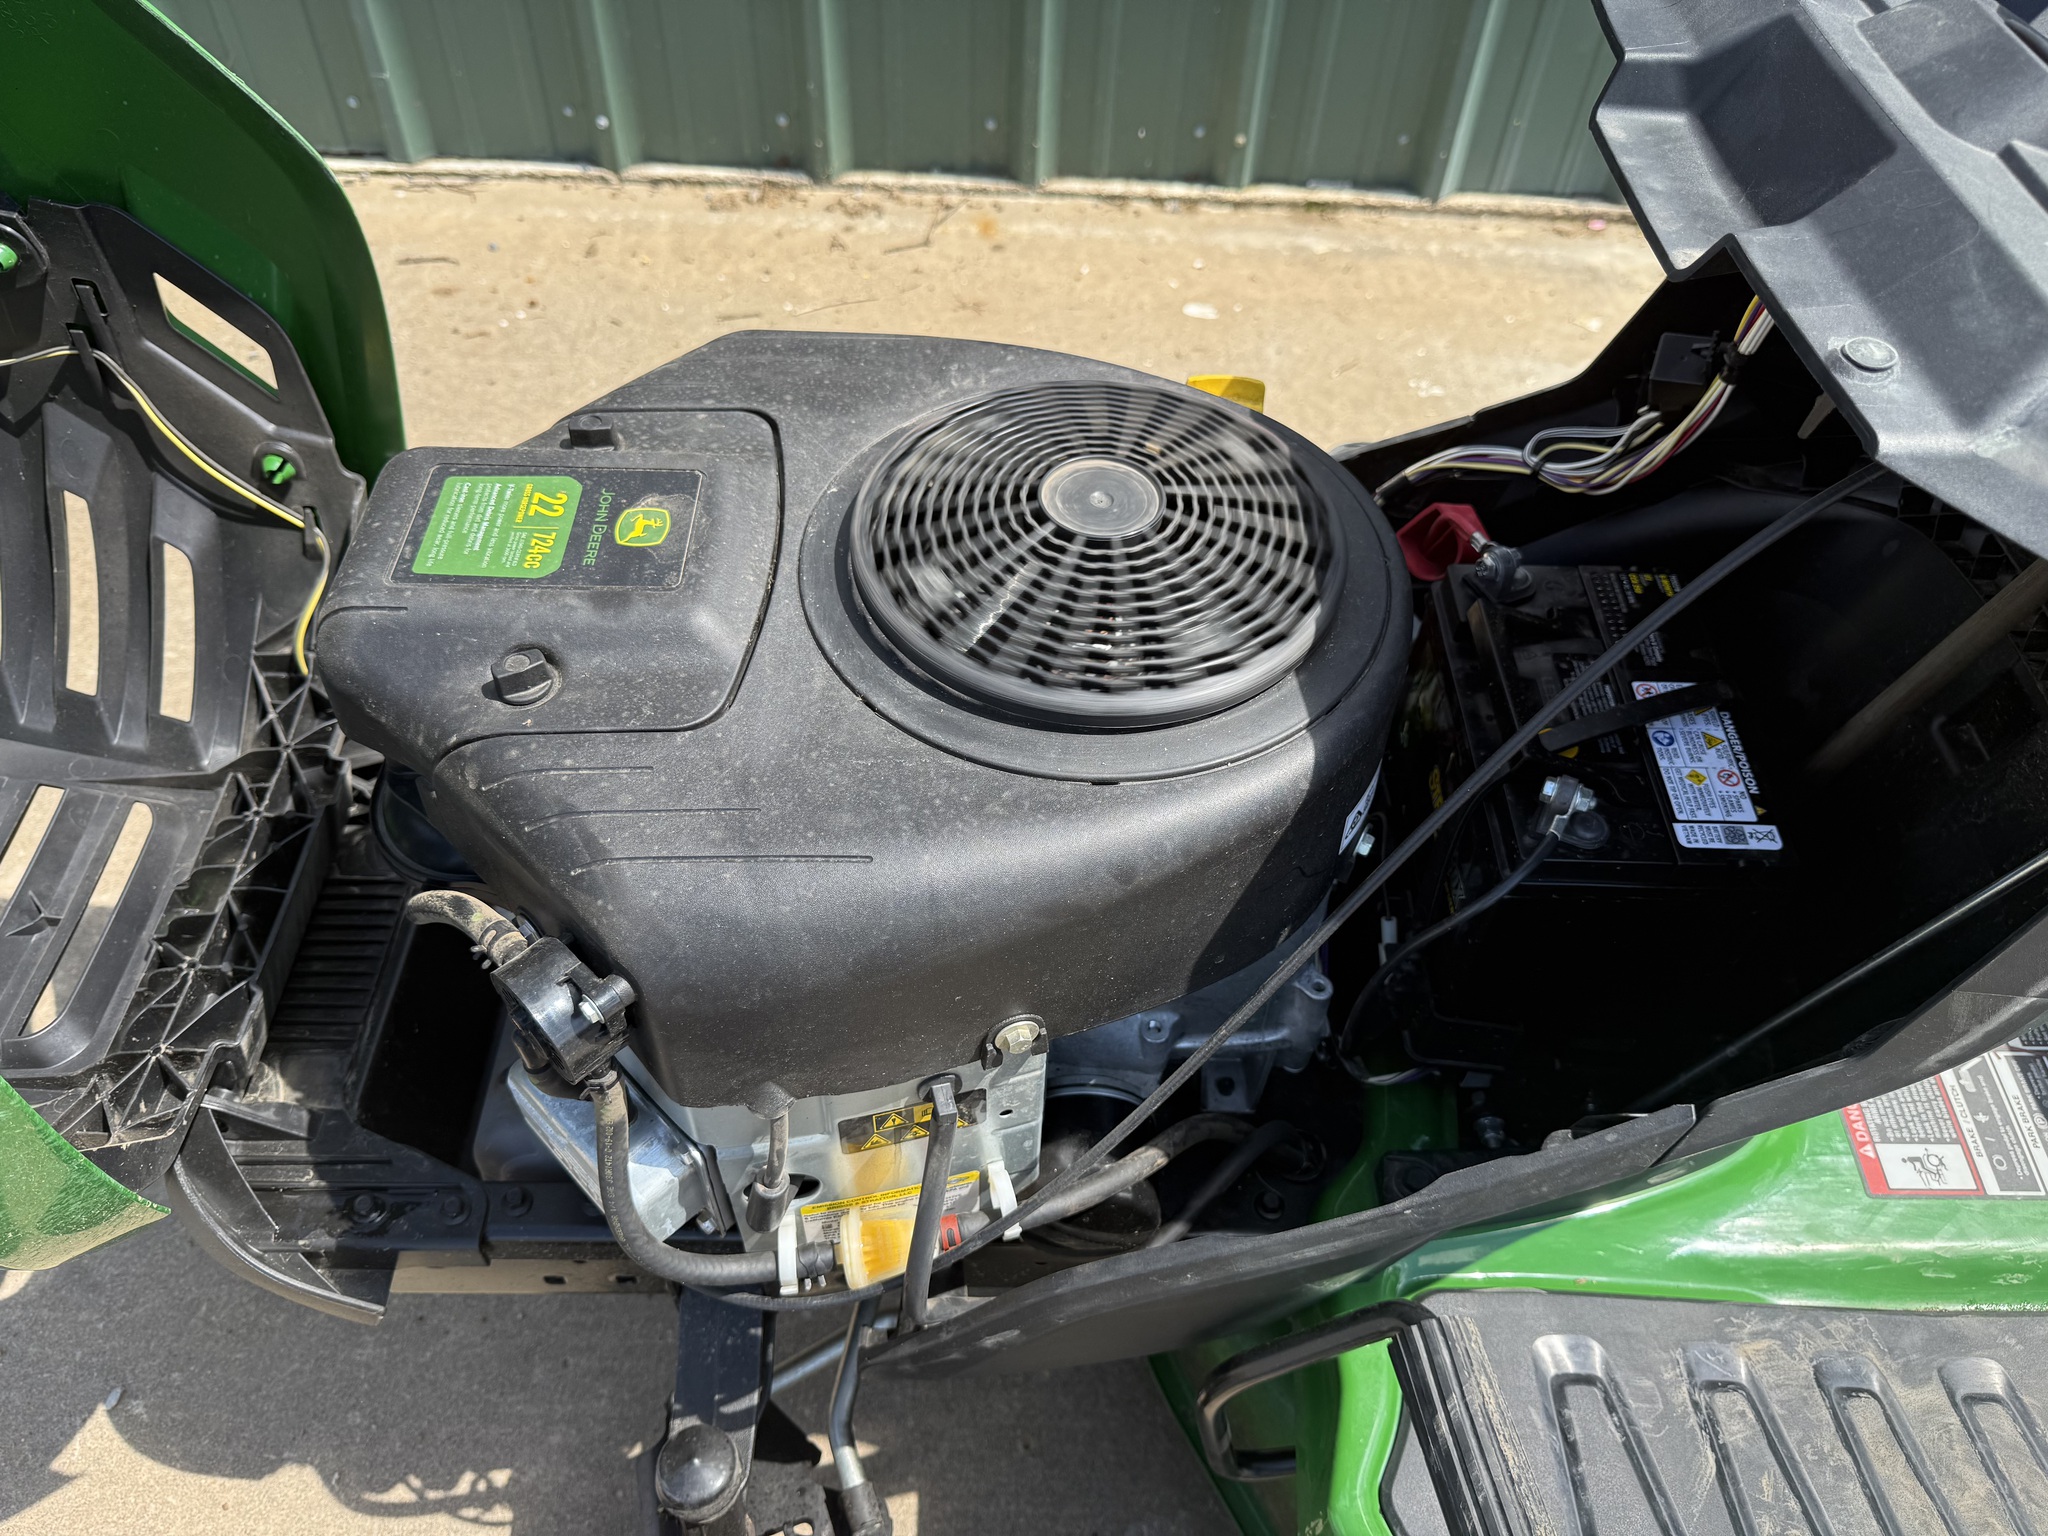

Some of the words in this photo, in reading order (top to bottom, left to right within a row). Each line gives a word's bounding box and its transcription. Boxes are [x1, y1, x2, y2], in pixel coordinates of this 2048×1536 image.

[488, 483, 502, 505] Advanced
[527, 492, 569, 516] 22
[594, 488, 616, 521] JOHN
[483, 506, 495, 520] Debris
[522, 531, 556, 568] 724cc
[582, 524, 607, 565] DEERE
[1720, 711, 1761, 794] DANGER/POISON
[1948, 1084, 1968, 1118] CLUTCH
[2011, 1094, 2029, 1123] BRAKE
[1844, 1103, 1869, 1141] DAN
[2024, 1125, 2040, 1148] PARK
[1965, 1127, 1983, 1157] BRAKE
[607, 1186, 615, 1198] SAE
[811, 1199, 844, 1210] EMISSION
[846, 1193, 877, 1203] CONTROL
